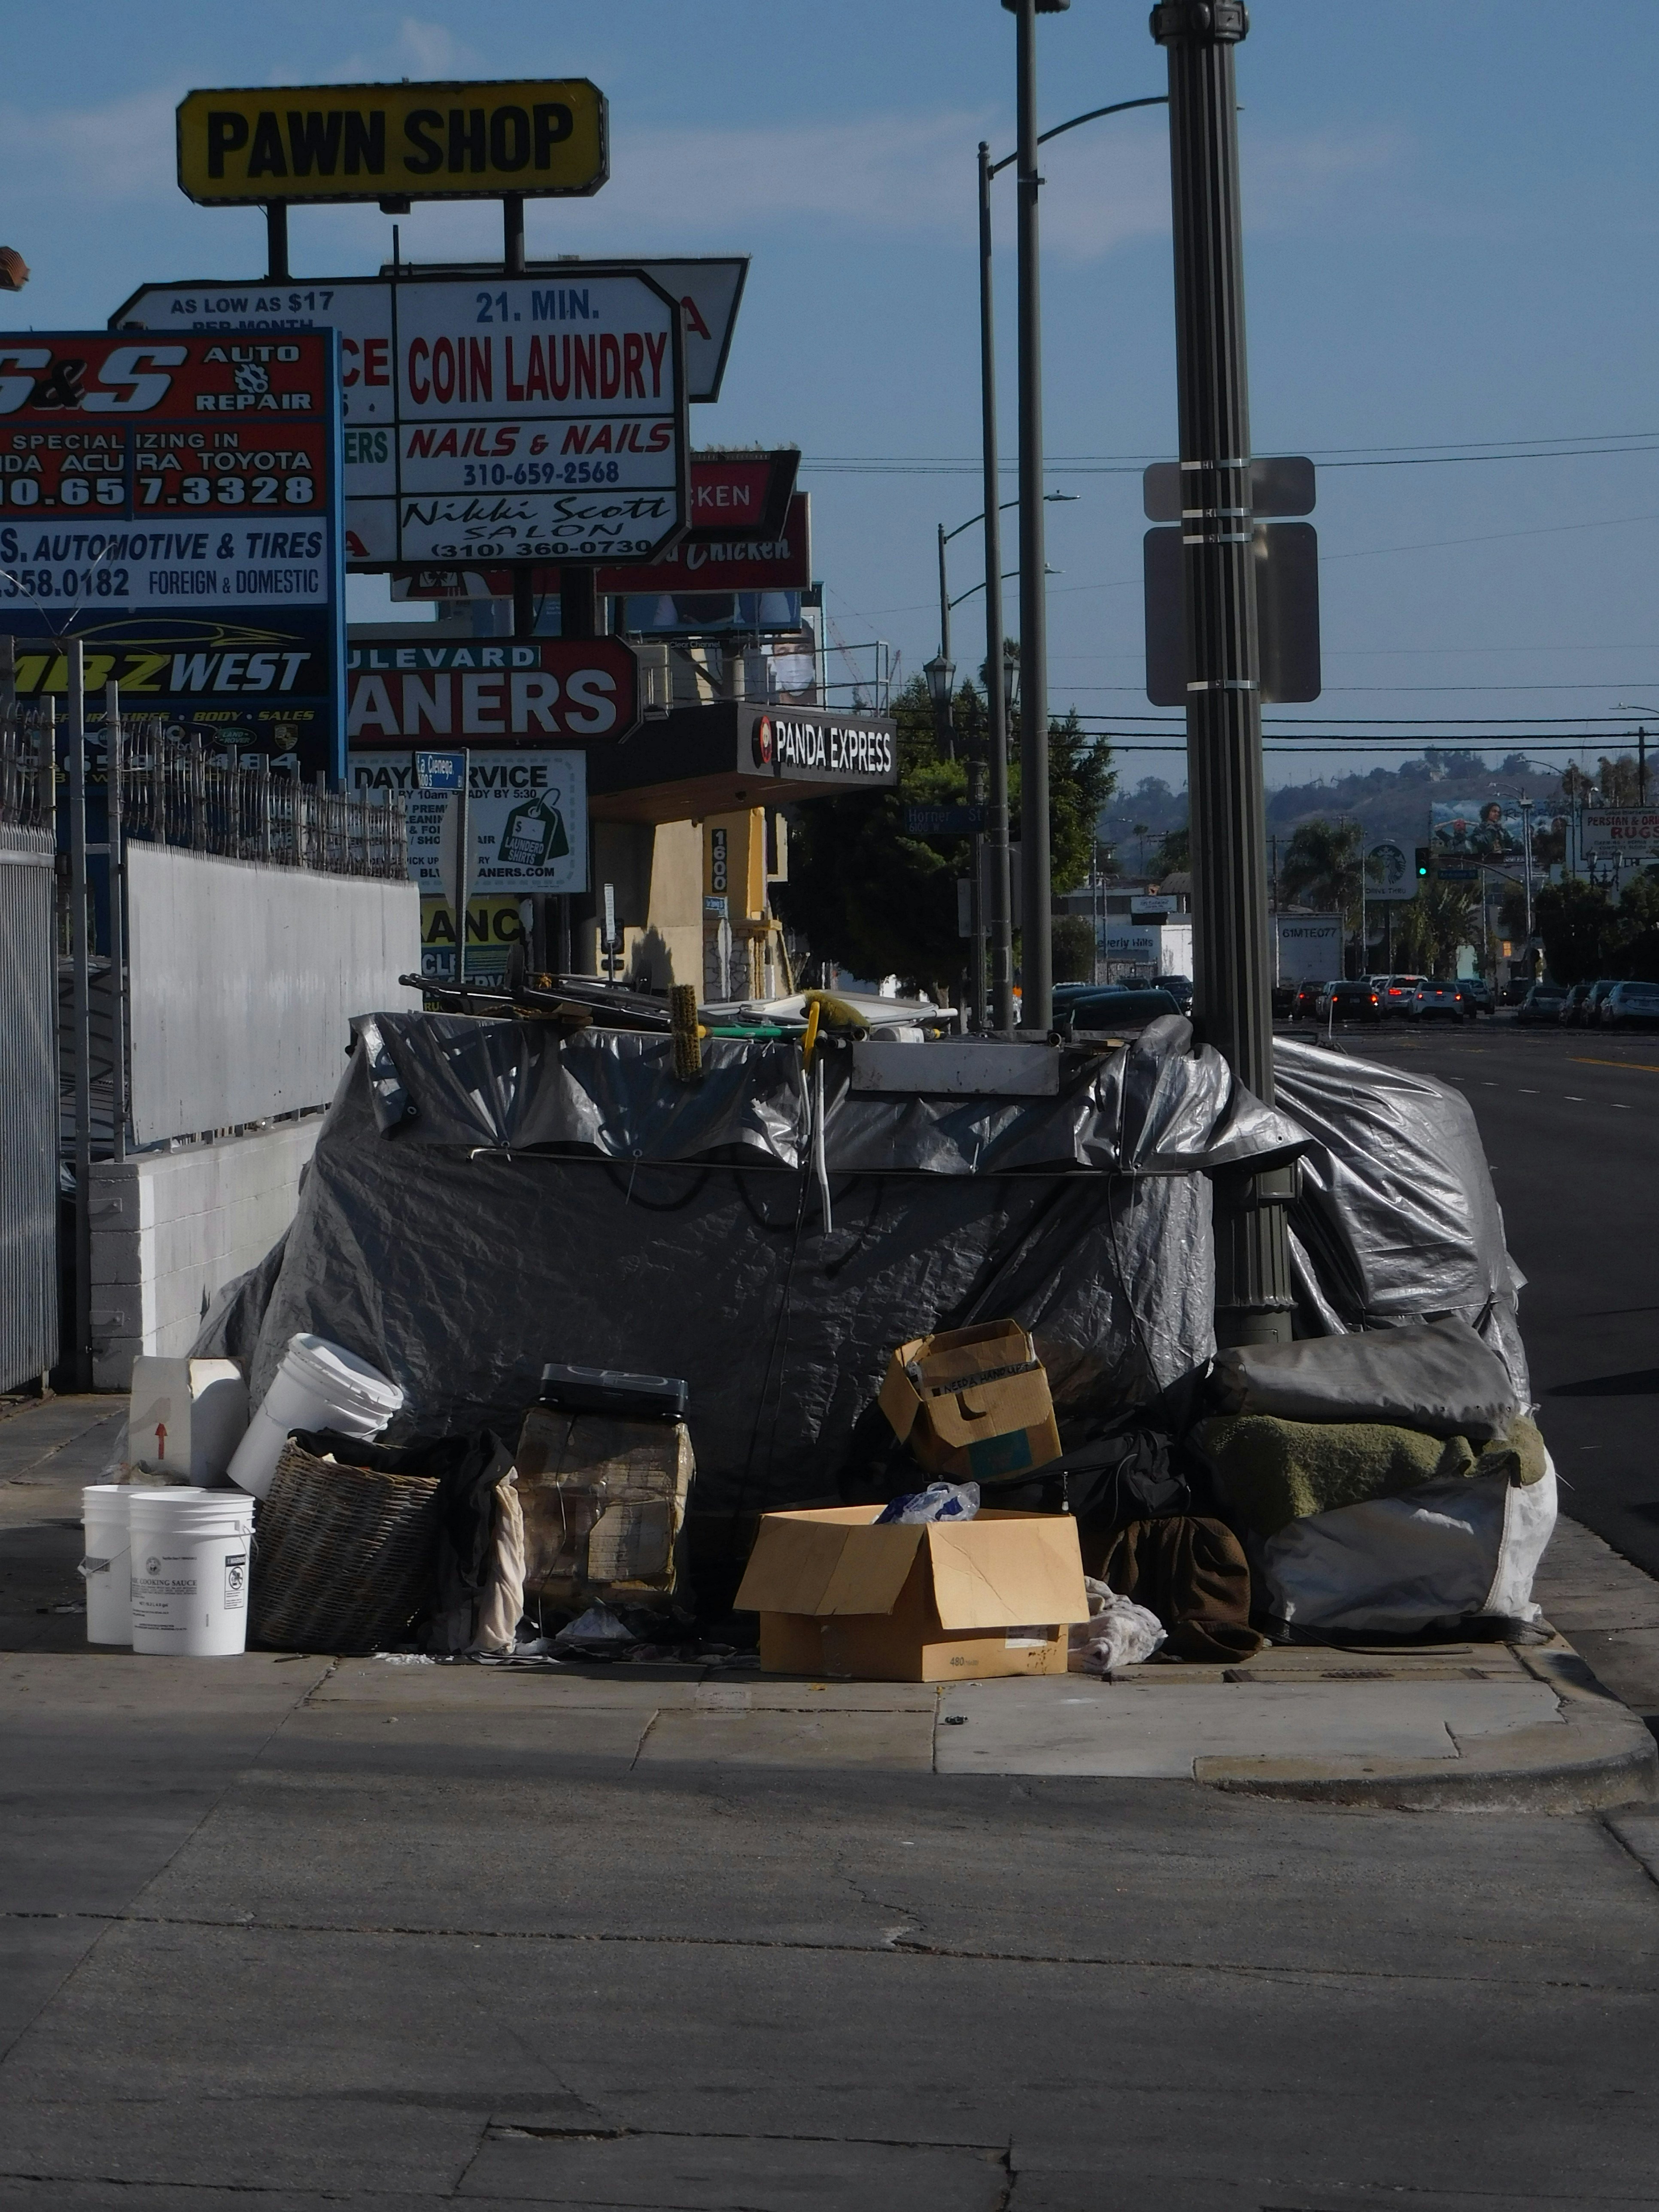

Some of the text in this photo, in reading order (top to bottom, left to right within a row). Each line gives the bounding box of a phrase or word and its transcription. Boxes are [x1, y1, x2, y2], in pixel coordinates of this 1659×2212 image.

[208, 103, 574, 178] PAWN SHOP
[171, 292, 334, 314] AS LOW AS $17
[476, 289, 599, 322] 21. MIN.
[203, 345, 300, 363] AUTO
[407, 331, 668, 404] COIN LAUNDRY
[196, 393, 312, 411] REPAIR
[214, 433, 239, 449] IN
[406, 423, 675, 459] NAILS & NAILS
[0, 454, 43, 473] DA
[197, 451, 312, 471] TOYOTA
[464, 461, 619, 486] 310-659-2568
[691, 485, 750, 507] KEN
[402, 497, 672, 528] Nikki Scott
[463, 523, 623, 540] SALON
[33, 533, 209, 562] AUTOMOTIVE
[216, 533, 235, 559] &
[246, 532, 323, 559] TIRES
[431, 543, 504, 557] (310)
[516, 539, 652, 556] 360-0730
[0, 568, 319, 598] 358.0182 FOREIGN & DOMESTIC
[348, 668, 617, 737] ANERS
[194, 711, 243, 722] BODY
[258, 711, 315, 721] SALES
[775, 721, 892, 772] PANDA EXPRESS
[355, 767, 411, 789] DAY
[418, 790, 448, 799] 10am
[494, 790, 509, 798] BY
[513, 789, 537, 798] 5:30
[413, 804, 447, 813] PREM
[908, 808, 981, 823] Horner St
[409, 826, 417, 834] &
[1587, 816, 1629, 826] PERSIAN
[1631, 816, 1639, 826] &
[504, 836, 544, 854] LAUNDERD
[507, 849, 536, 865] SHIRTS
[714, 830, 726, 890] 1600
[477, 867, 554, 877] ANERS.COM
[420, 908, 520, 943] ANC
[980, 1367, 1006, 1382] HAND
[140, 1578, 170, 1586] COOKING
[950, 1656, 964, 1667] 480
